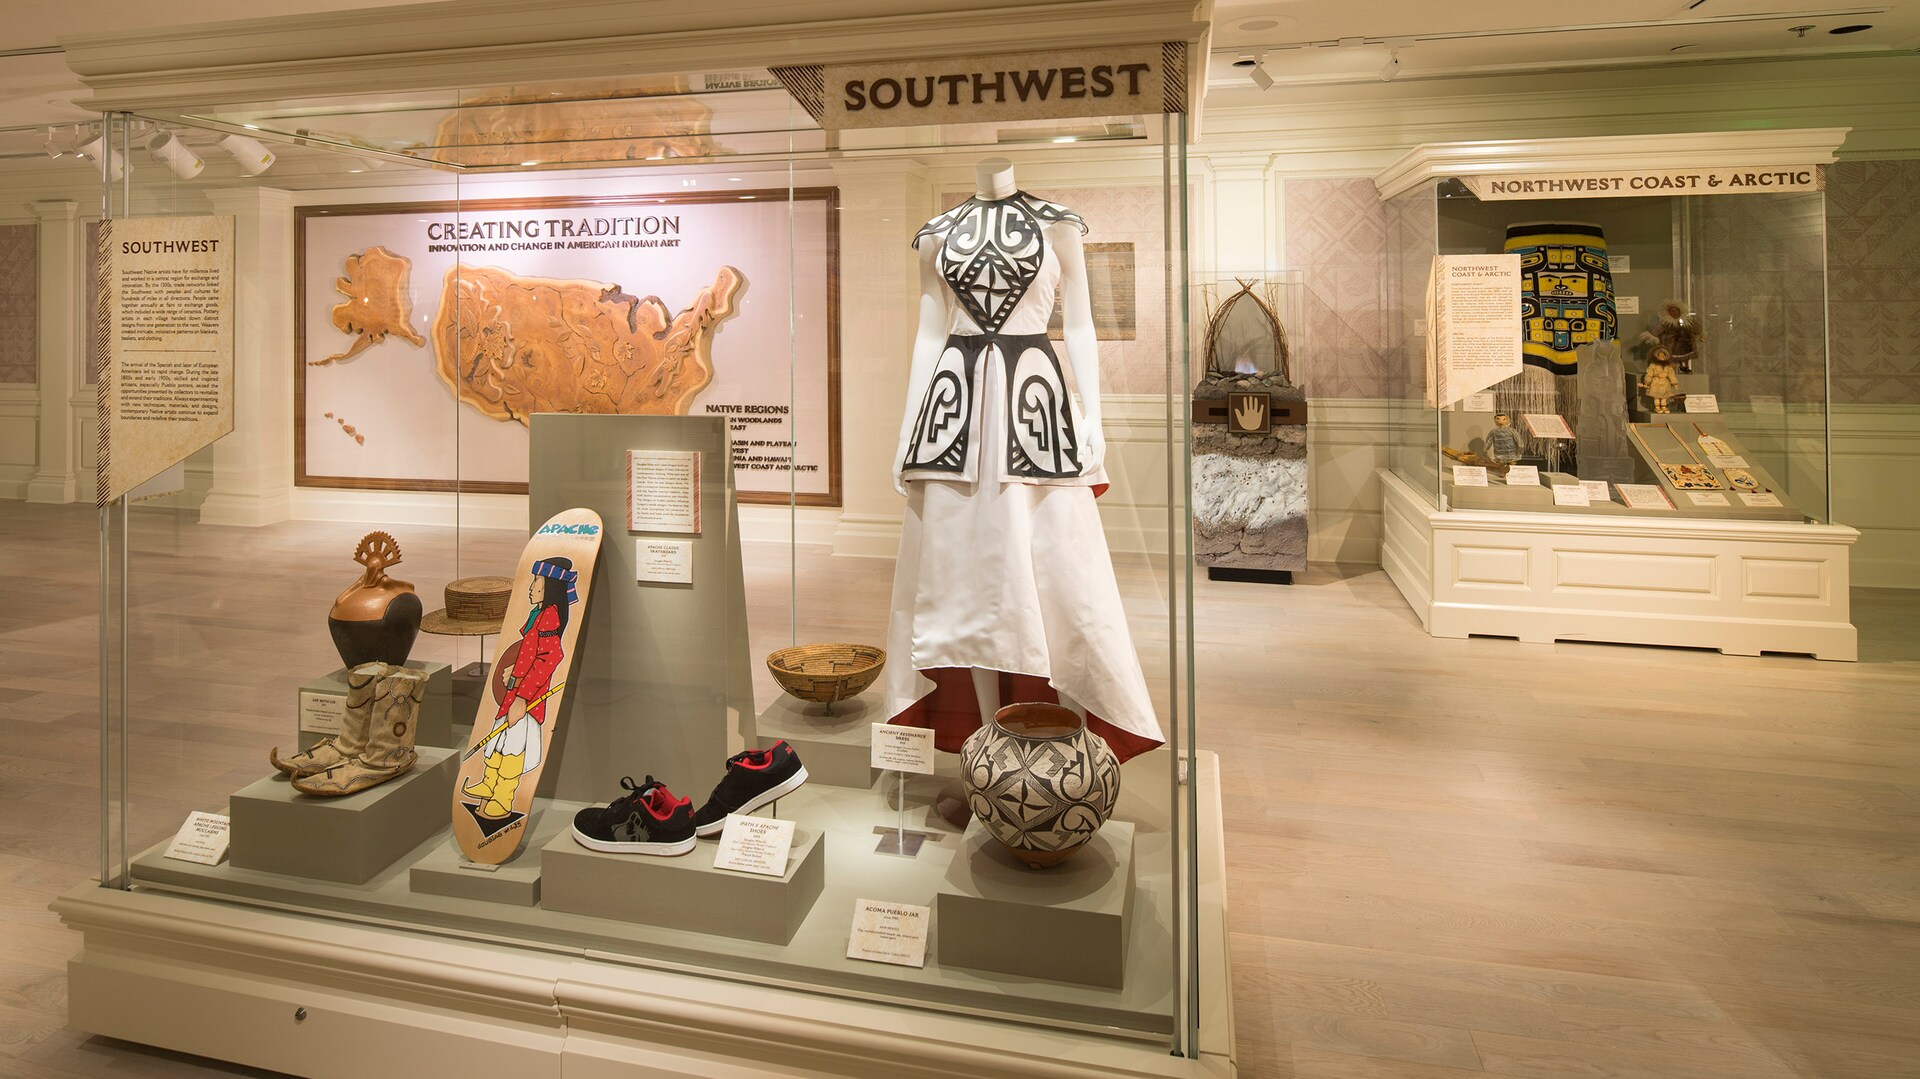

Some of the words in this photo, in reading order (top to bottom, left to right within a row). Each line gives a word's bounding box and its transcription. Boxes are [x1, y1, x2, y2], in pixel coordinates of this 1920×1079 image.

[844, 62, 1150, 111] SOUTHWEST
[1491, 178, 1624, 194] NORTHWEST
[1630, 175, 1700, 189] COAST
[1707, 175, 1723, 187] &
[1728, 172, 1811, 186] ARCTIC
[428, 220, 540, 240] CREATING
[544, 216, 680, 237] TRADITION
[122, 240, 219, 254] SOUTHWEST
[428, 243, 486, 252] INNOVATION
[488, 242, 509, 251] AND
[510, 241, 552, 251] CHANGE
[554, 241, 564, 249] IN
[566, 240, 620, 249] AMERICAN
[622, 239, 658, 248] INDIAN
[660, 239, 681, 247] ART
[706, 404, 742, 413] NATIVE
[745, 405, 789, 414] REGIONS
